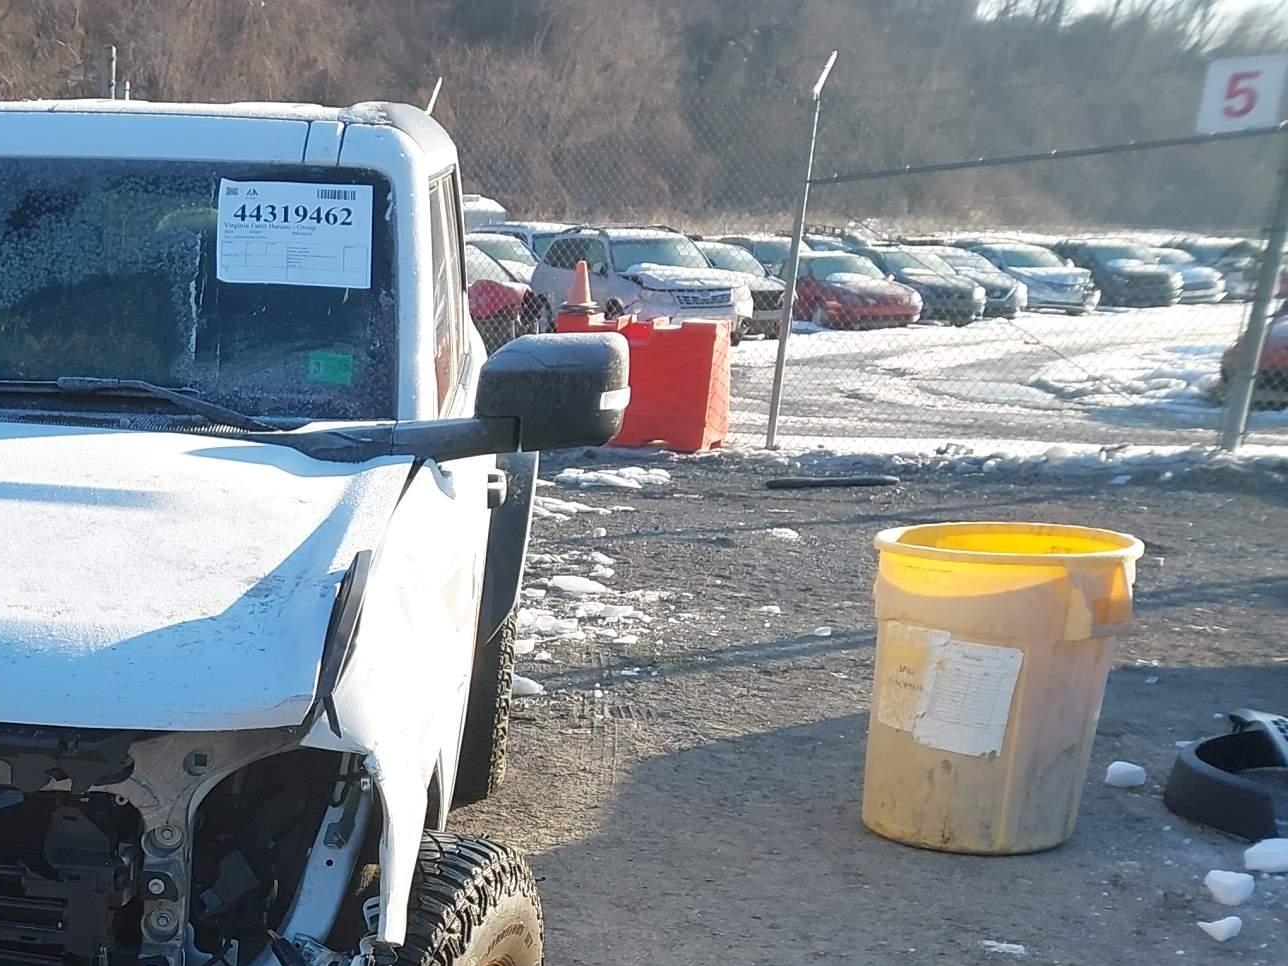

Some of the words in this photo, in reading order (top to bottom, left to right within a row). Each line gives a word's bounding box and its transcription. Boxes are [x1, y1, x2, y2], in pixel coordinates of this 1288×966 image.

[1223, 69, 1262, 119] 5
[232, 203, 353, 227] 44319462
[223, 223, 250, 231] Virginia
[297, 224, 317, 232] Group
